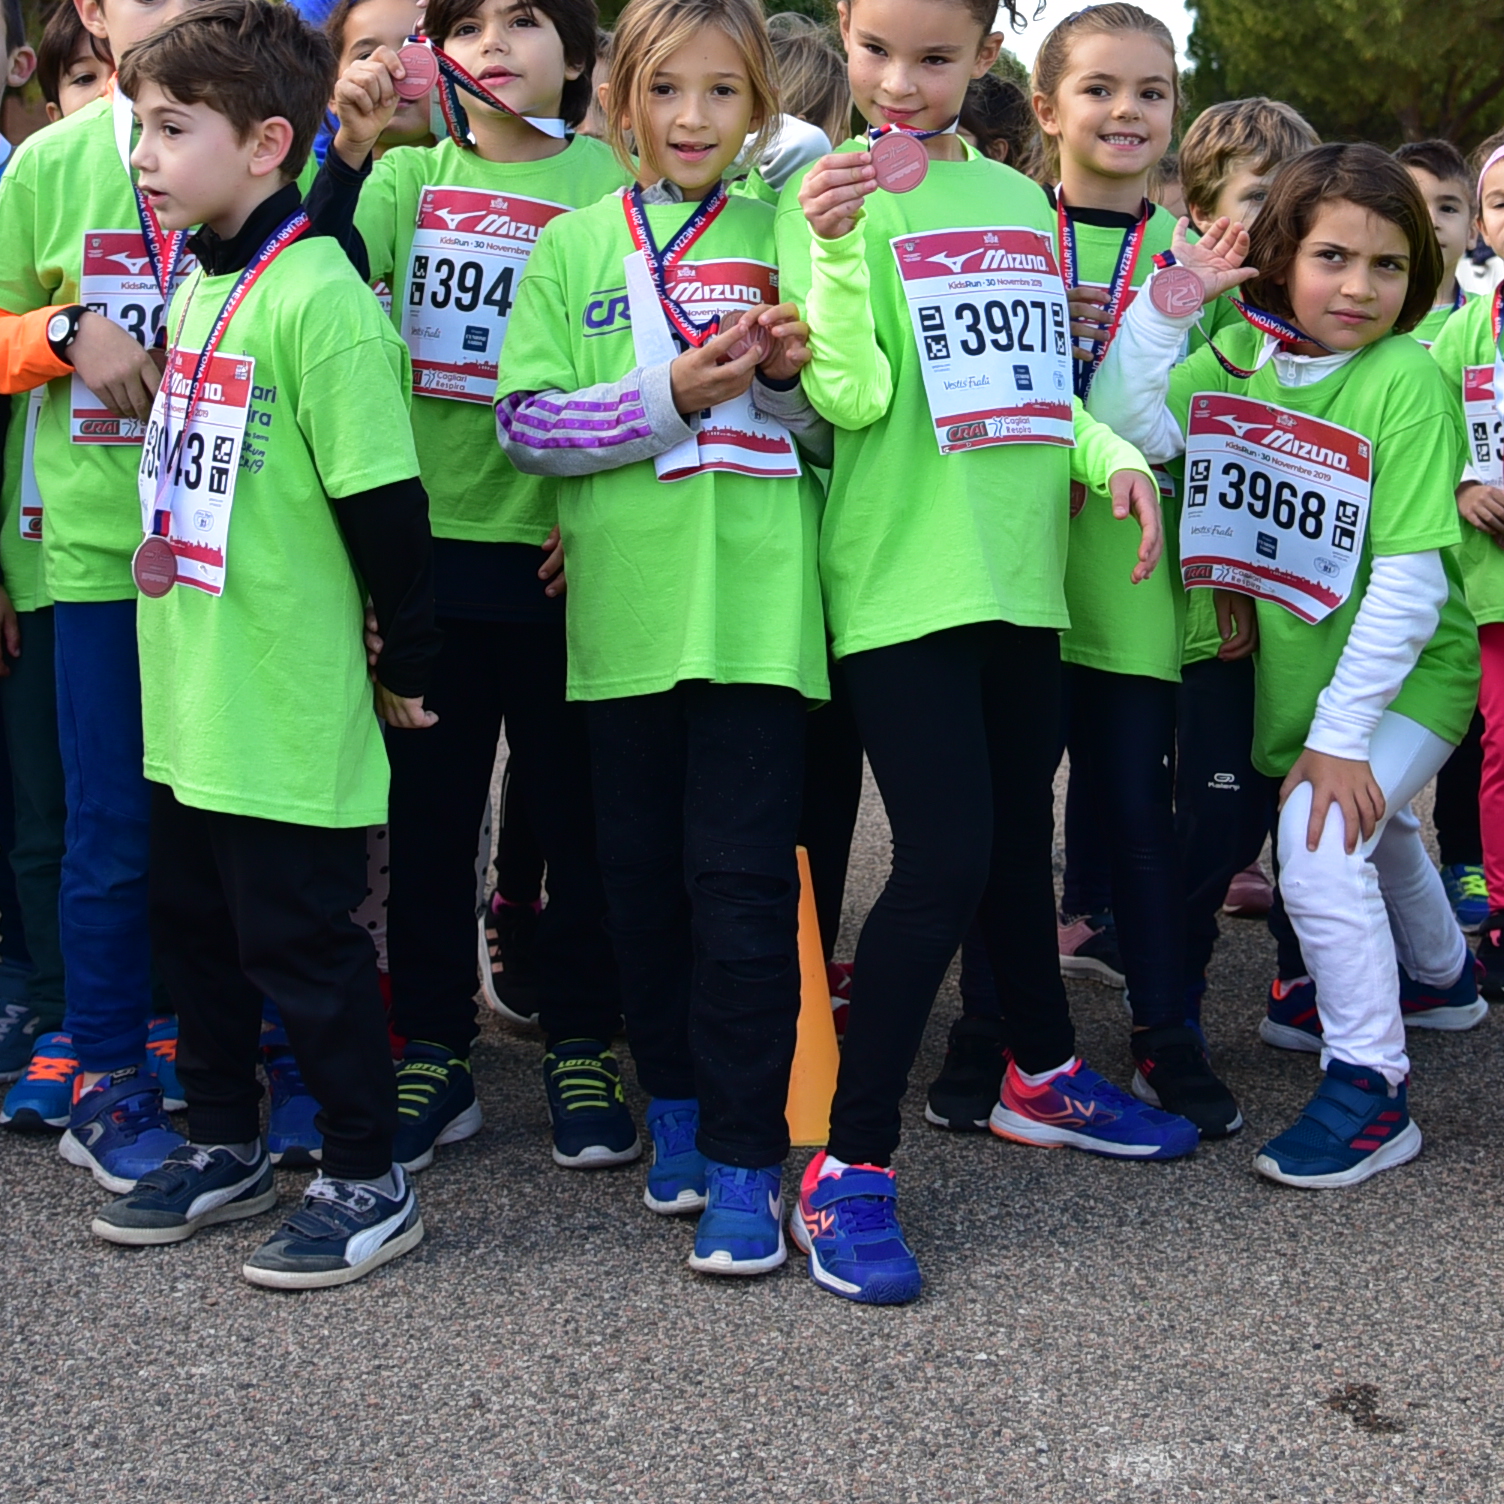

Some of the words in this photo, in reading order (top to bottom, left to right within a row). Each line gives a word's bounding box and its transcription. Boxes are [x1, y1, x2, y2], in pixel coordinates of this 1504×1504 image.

[706, 195, 720, 213] 2019
[629, 206, 644, 225] 2019
[439, 237, 470, 247] KidsRun
[474, 240, 485, 249] 30
[486, 242, 531, 256] Novembre
[670, 224, 697, 254] MEZZA
[1063, 226, 1072, 247] 2019
[150, 241, 161, 255] DI
[259, 239, 282, 263] 2019
[980, 249, 1047, 271] MIZUNO
[1063, 247, 1074, 291] CAGLIARI
[1119, 245, 1135, 277] MEZZA
[430, 258, 515, 318] 394
[670, 282, 761, 302] MIZUNO
[948, 280, 982, 290] KidsRun
[985, 278, 996, 287] 30
[997, 278, 1030, 286] Novembre
[220, 283, 247, 322] MEZZA
[954, 299, 1047, 357] 3927
[1245, 308, 1296, 341] MARATONA
[195, 319, 225, 380] MARATONA
[435, 380, 466, 391] Respira
[436, 372, 468, 383] Cagliari
[80, 420, 119, 435] CRAI
[947, 421, 988, 443] CRAI
[1260, 429, 1348, 469] MIZUNO
[1225, 440, 1257, 458] KidsRun
[1260, 452, 1271, 463] 30
[1271, 458, 1312, 477] Novembre
[1313, 470, 1332, 482] 2019
[1218, 462, 1326, 540] 3968
[404, 1062, 449, 1075] LOTTO
[557, 1058, 601, 1068] LOTTO
